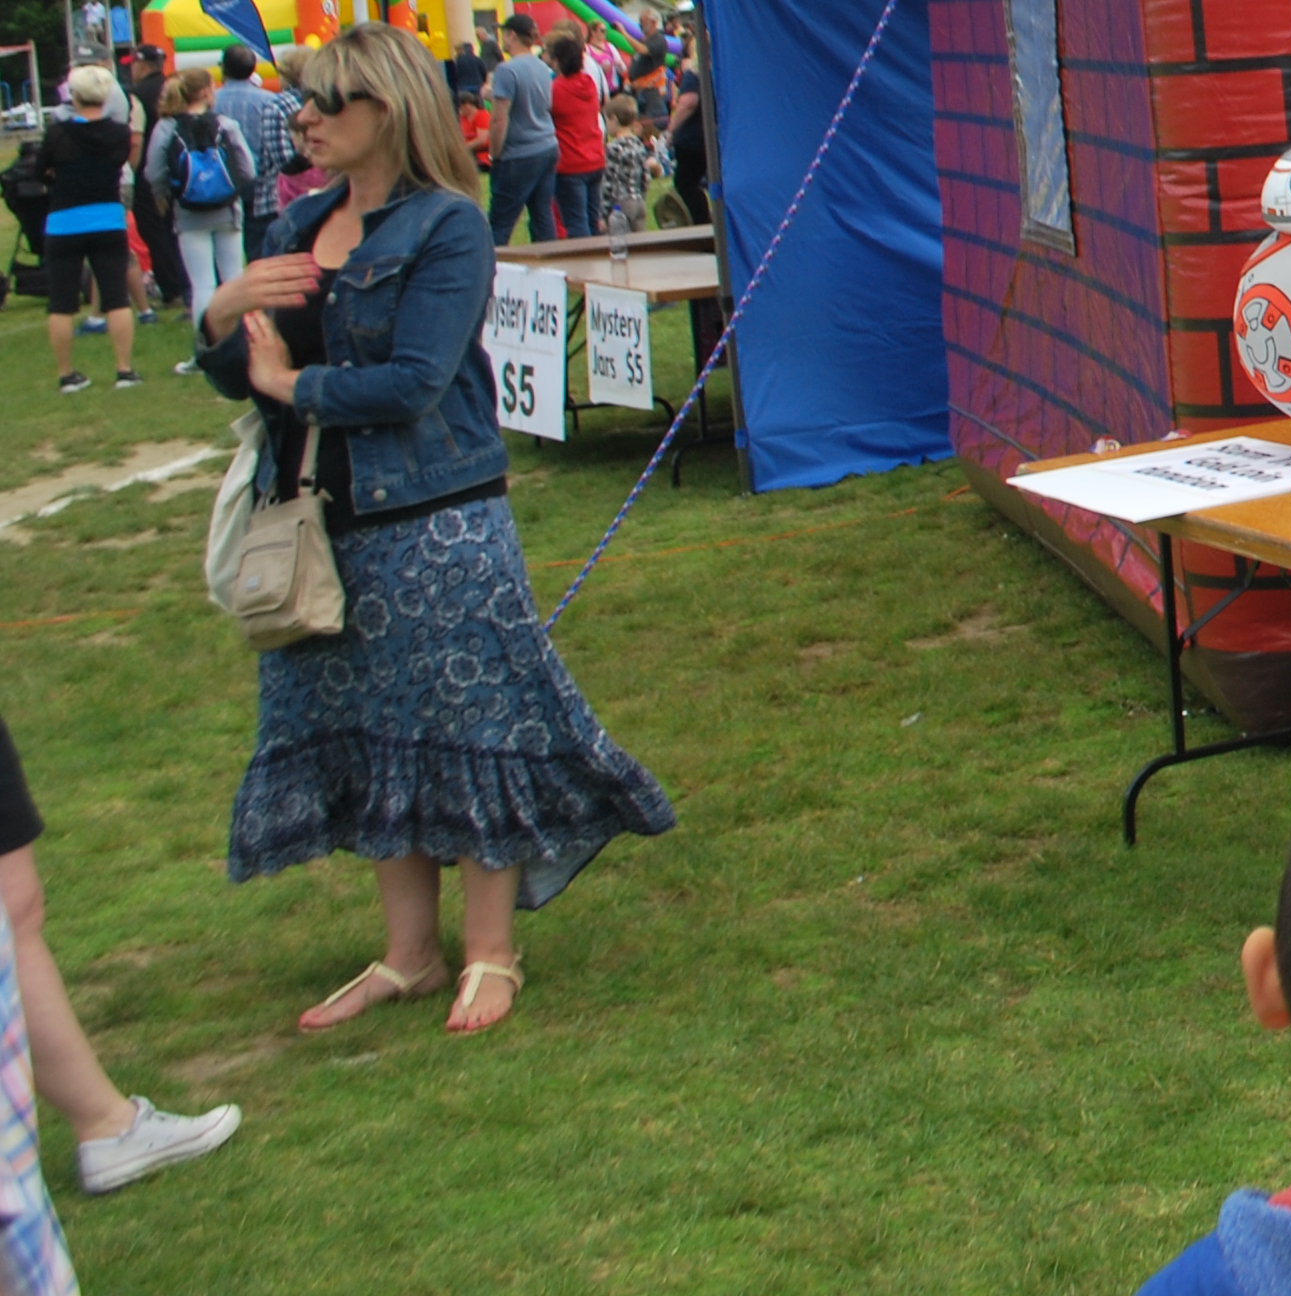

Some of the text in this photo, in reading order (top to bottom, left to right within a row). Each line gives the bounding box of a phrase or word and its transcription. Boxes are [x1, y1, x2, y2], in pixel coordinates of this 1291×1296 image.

[530, 289, 558, 337] Jars
[590, 299, 642, 349] Mystery
[501, 357, 536, 421] $5
[625, 348, 645, 388] $5
